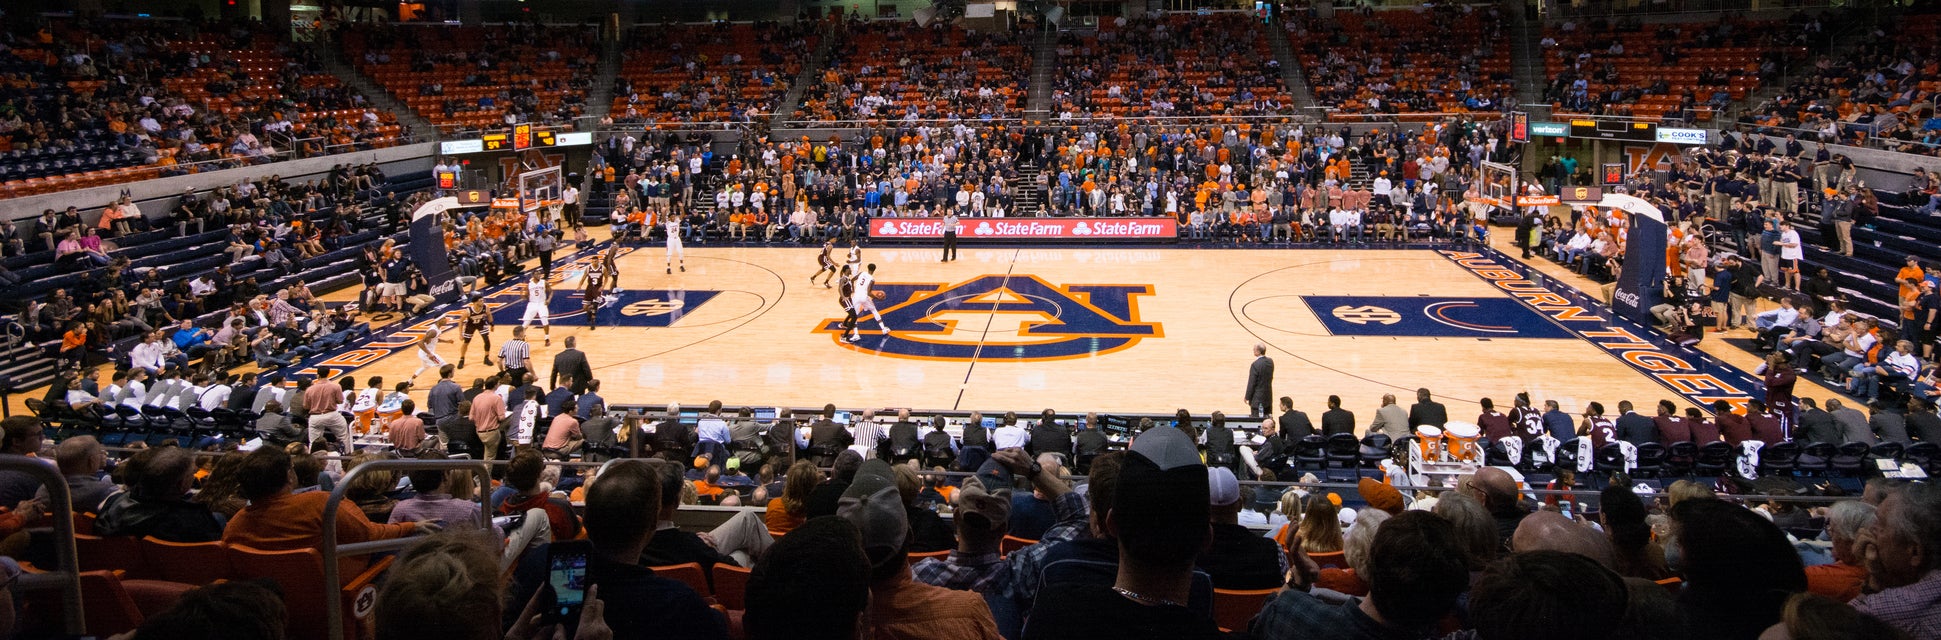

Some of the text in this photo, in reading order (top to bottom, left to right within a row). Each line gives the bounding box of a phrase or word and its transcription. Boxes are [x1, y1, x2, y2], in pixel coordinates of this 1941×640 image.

[1532, 125, 1563, 134] verizon
[487, 140, 500, 149] 59
[542, 137, 554, 145] 40
[120, 188, 132, 198] M
[860, 278, 866, 286] 3
[1436, 248, 1607, 323] AUBURN
[534, 289, 540, 297] 5
[1525, 419, 1544, 434] 34
[1602, 427, 1616, 443] 2
[1428, 441, 1436, 449] G
[1463, 442, 1471, 450] G
